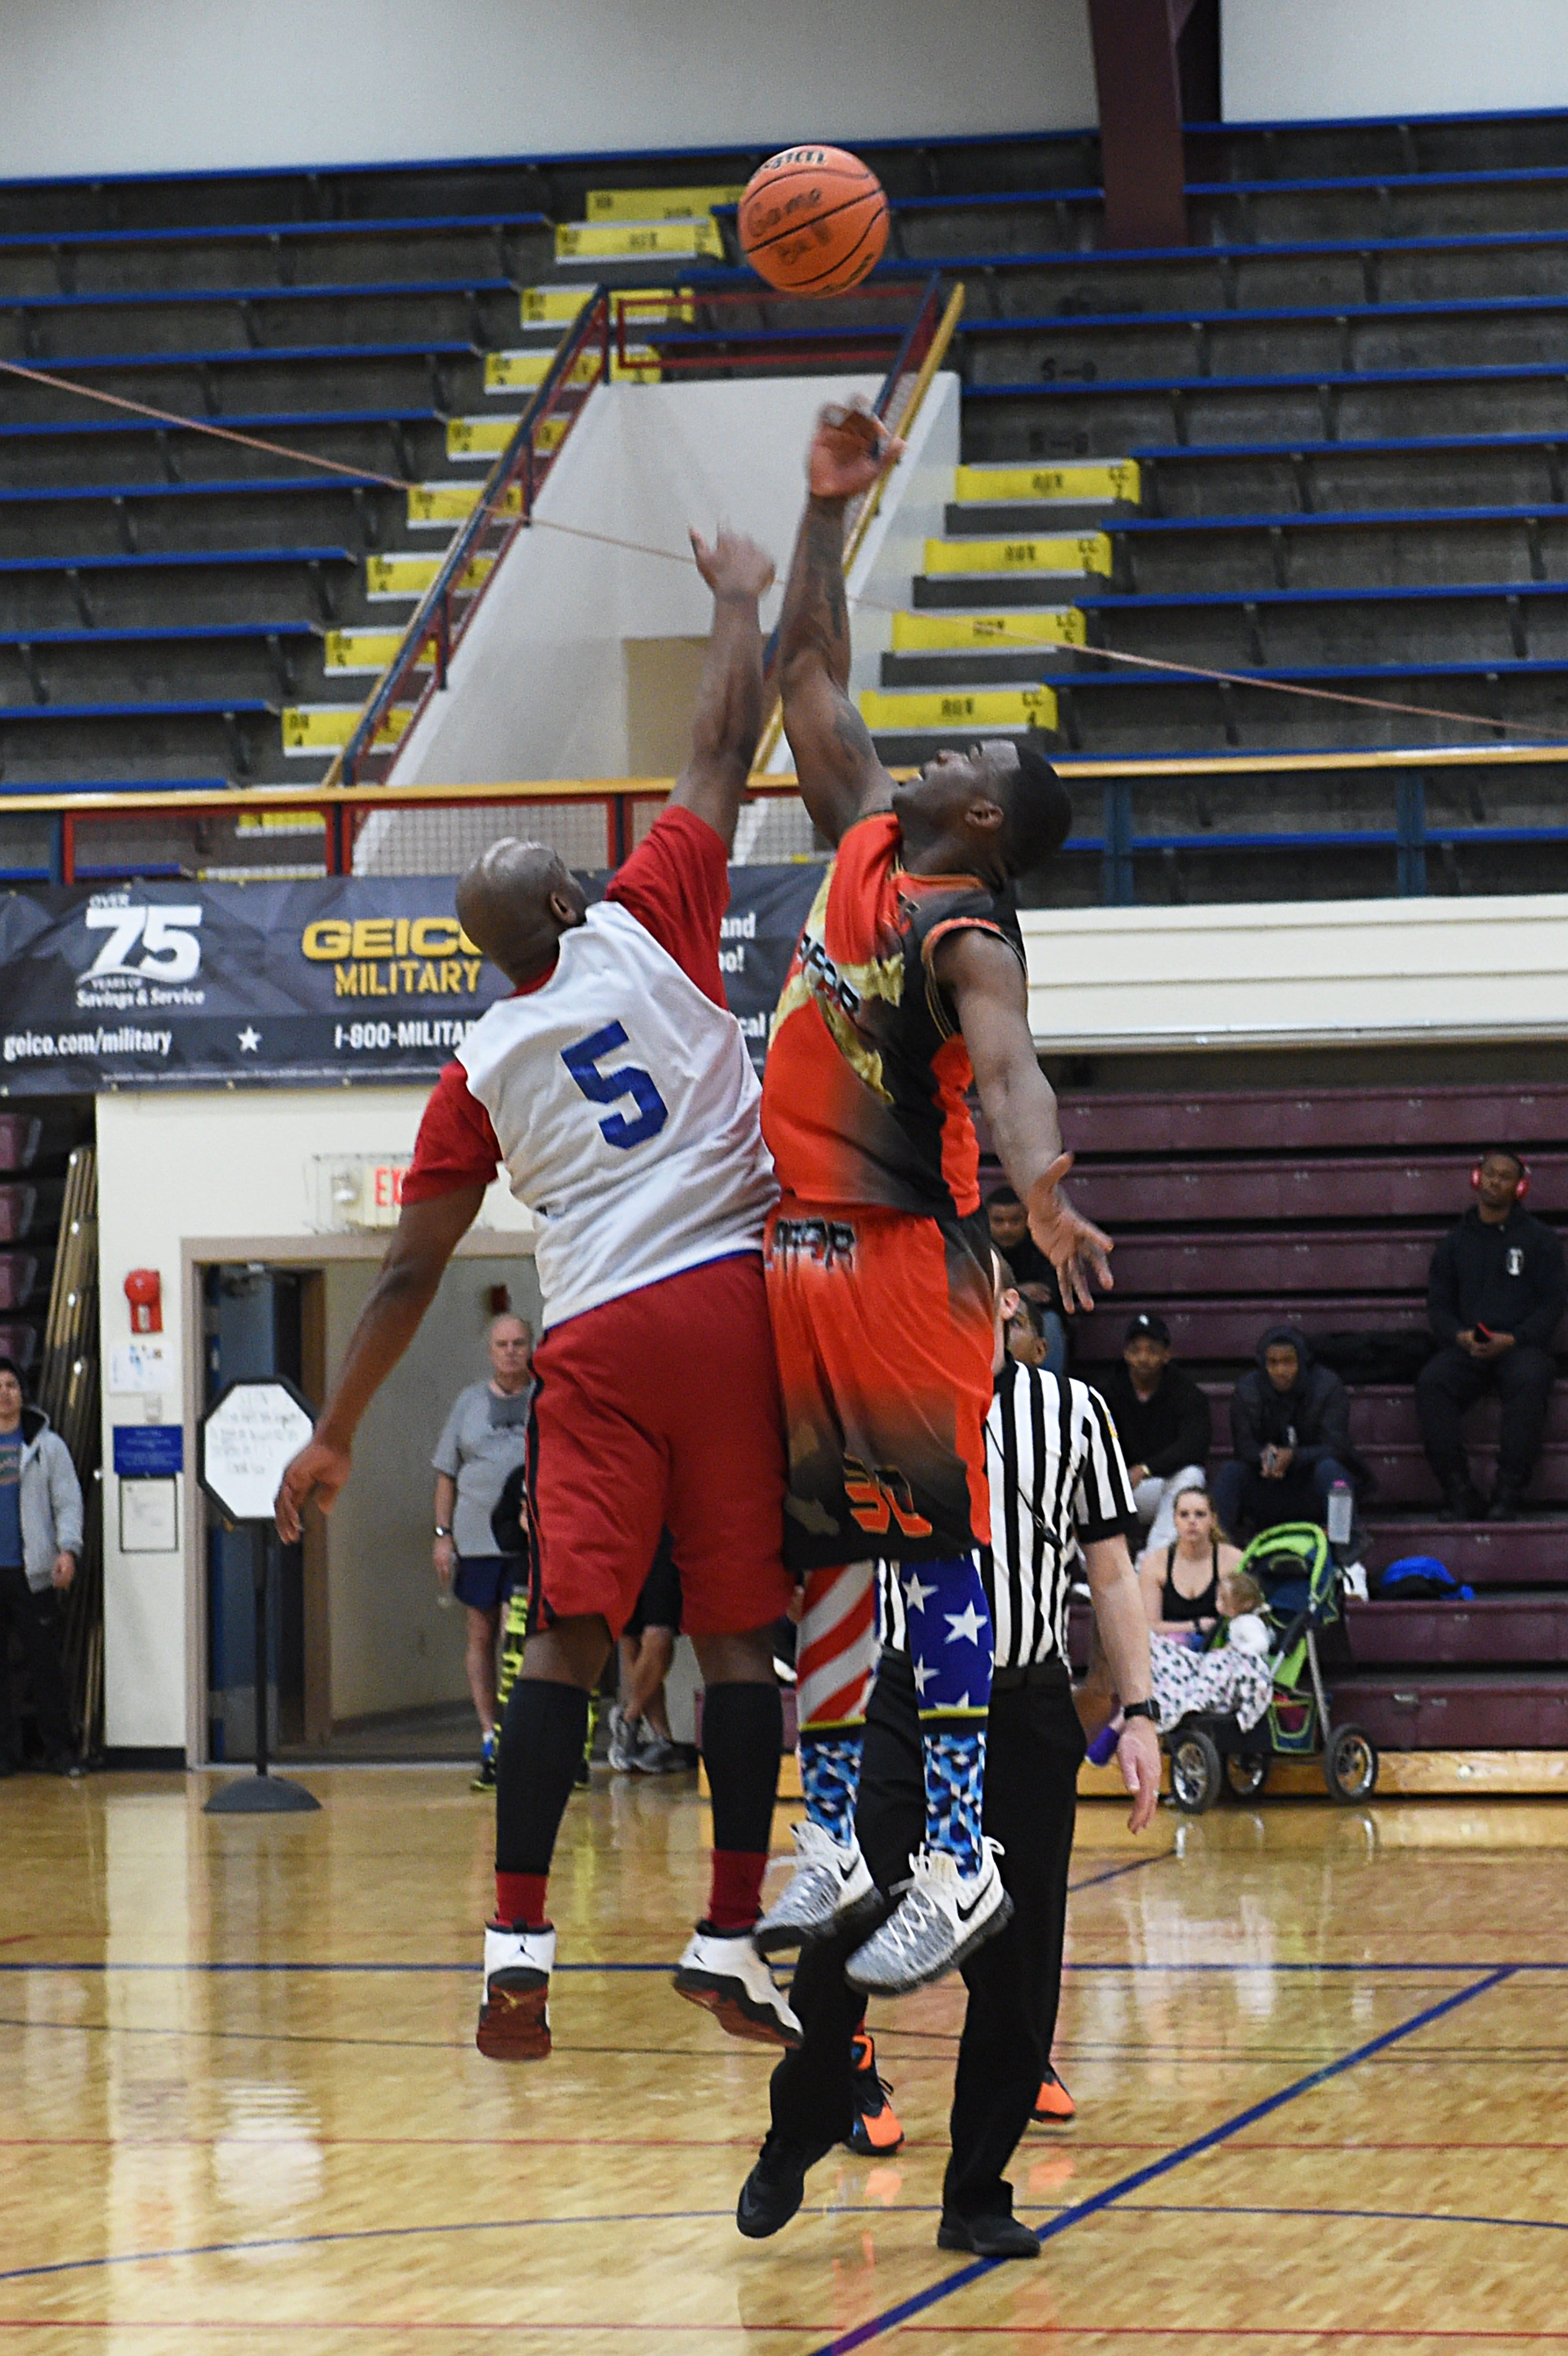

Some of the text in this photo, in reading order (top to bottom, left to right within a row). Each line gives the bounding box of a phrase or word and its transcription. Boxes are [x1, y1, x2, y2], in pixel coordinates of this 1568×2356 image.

[86, 905, 202, 983] 75
[76, 987, 205, 1009] Savings & Service
[335, 959, 481, 996] MILITARY
[4, 1026, 172, 1062] geico.com/military
[335, 1020, 478, 1050] 1-800-MILITA
[560, 1019, 669, 1149] 5
[375, 1167, 403, 1207] EX
